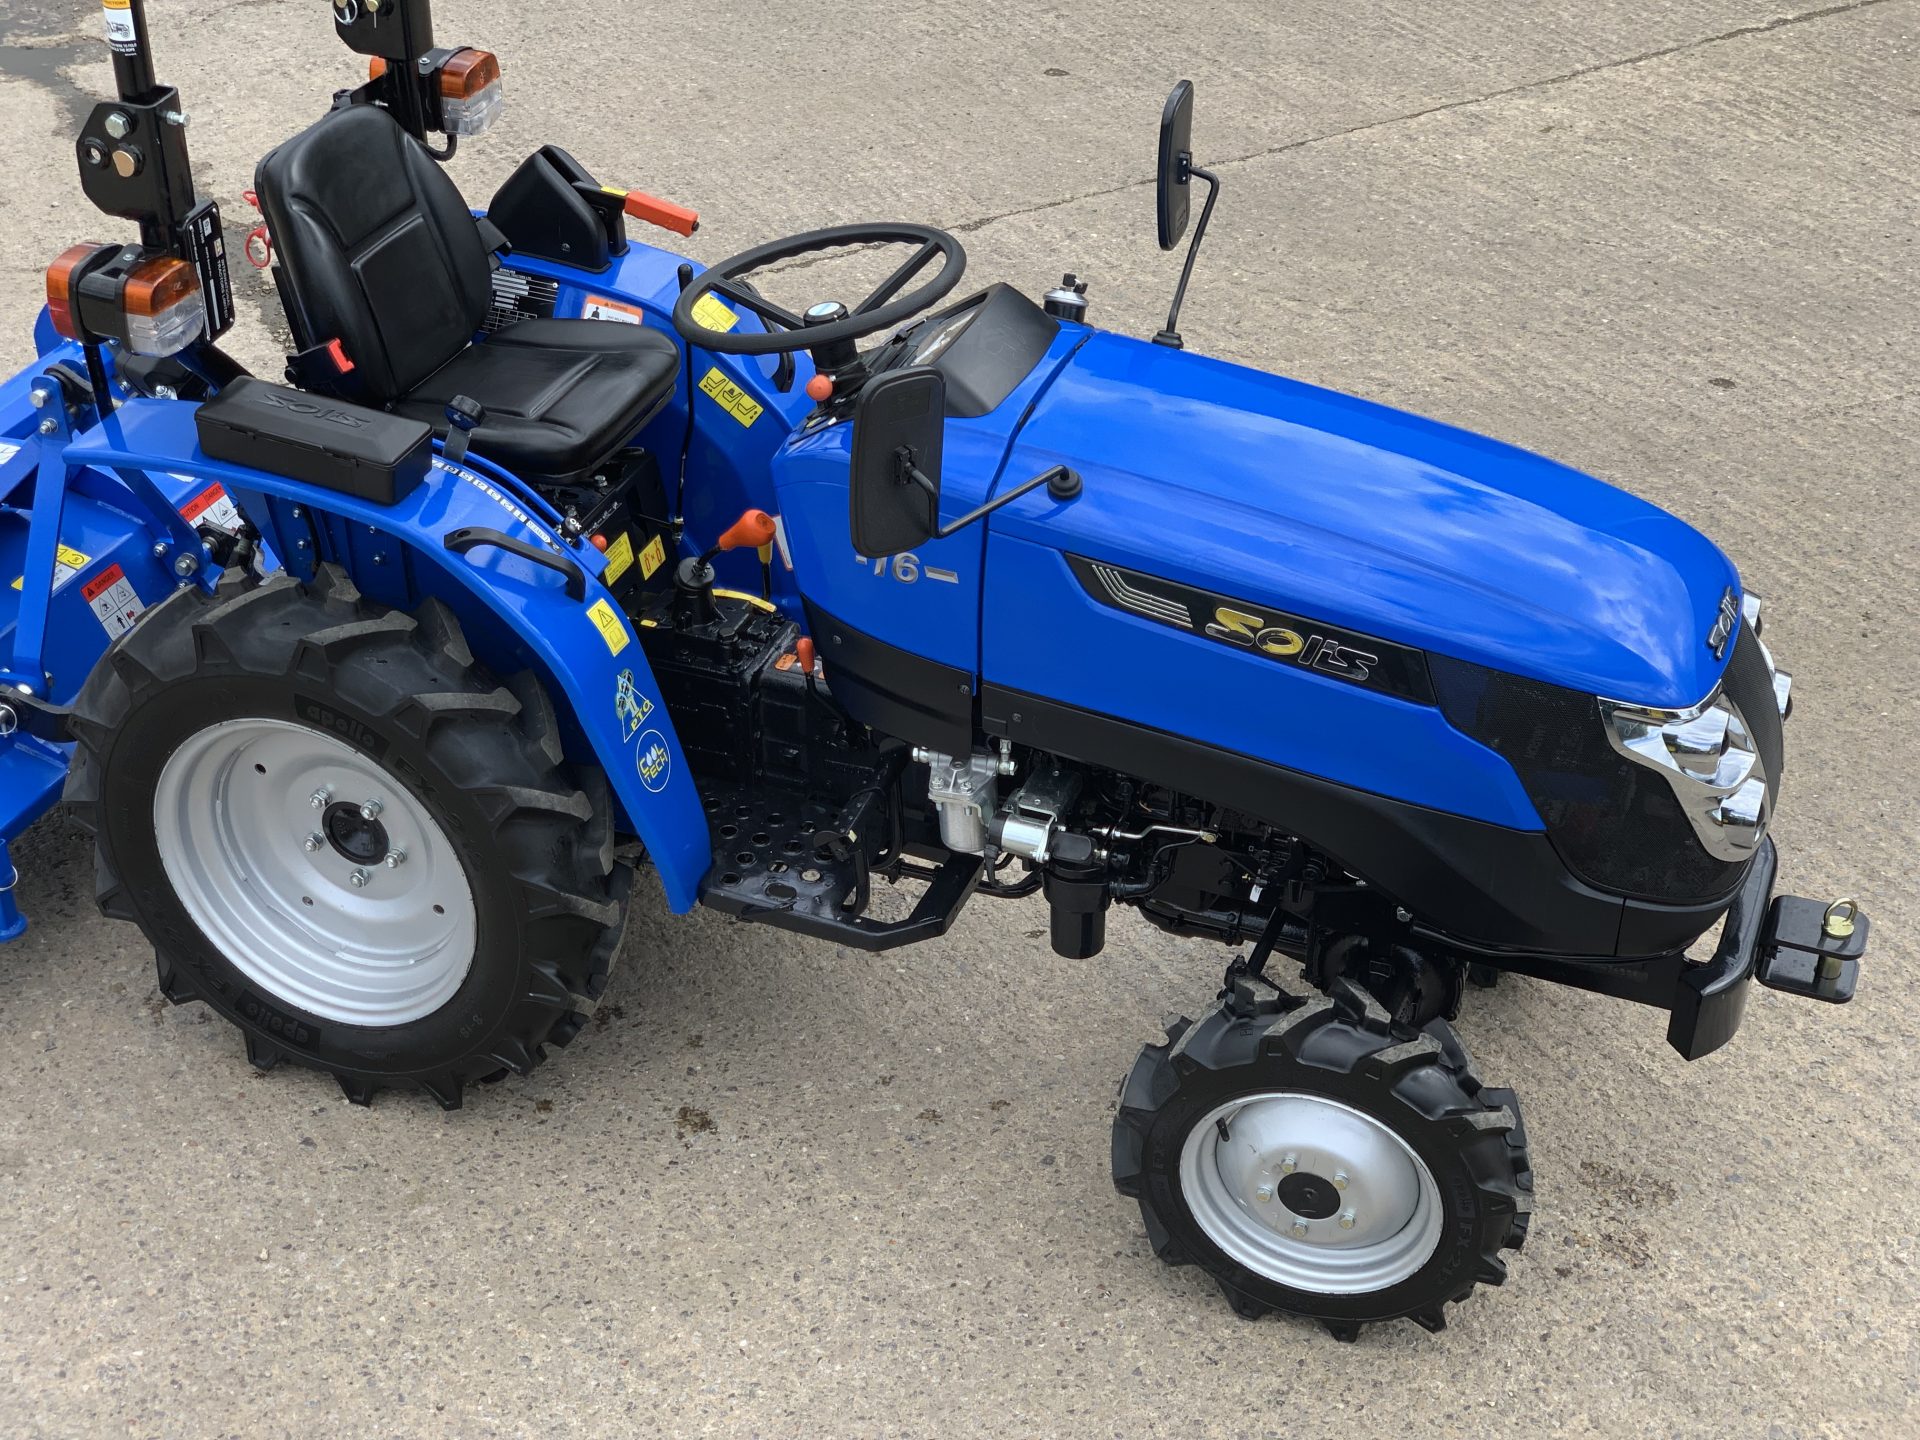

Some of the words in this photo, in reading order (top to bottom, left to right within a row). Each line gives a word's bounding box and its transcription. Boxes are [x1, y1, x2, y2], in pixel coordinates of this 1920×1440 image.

[569, 517, 583, 531] OK
[306, 704, 376, 748] apollo
[630, 699, 651, 732] PTO
[644, 751, 669, 784] TECH
[244, 1001, 311, 1044] apollo
